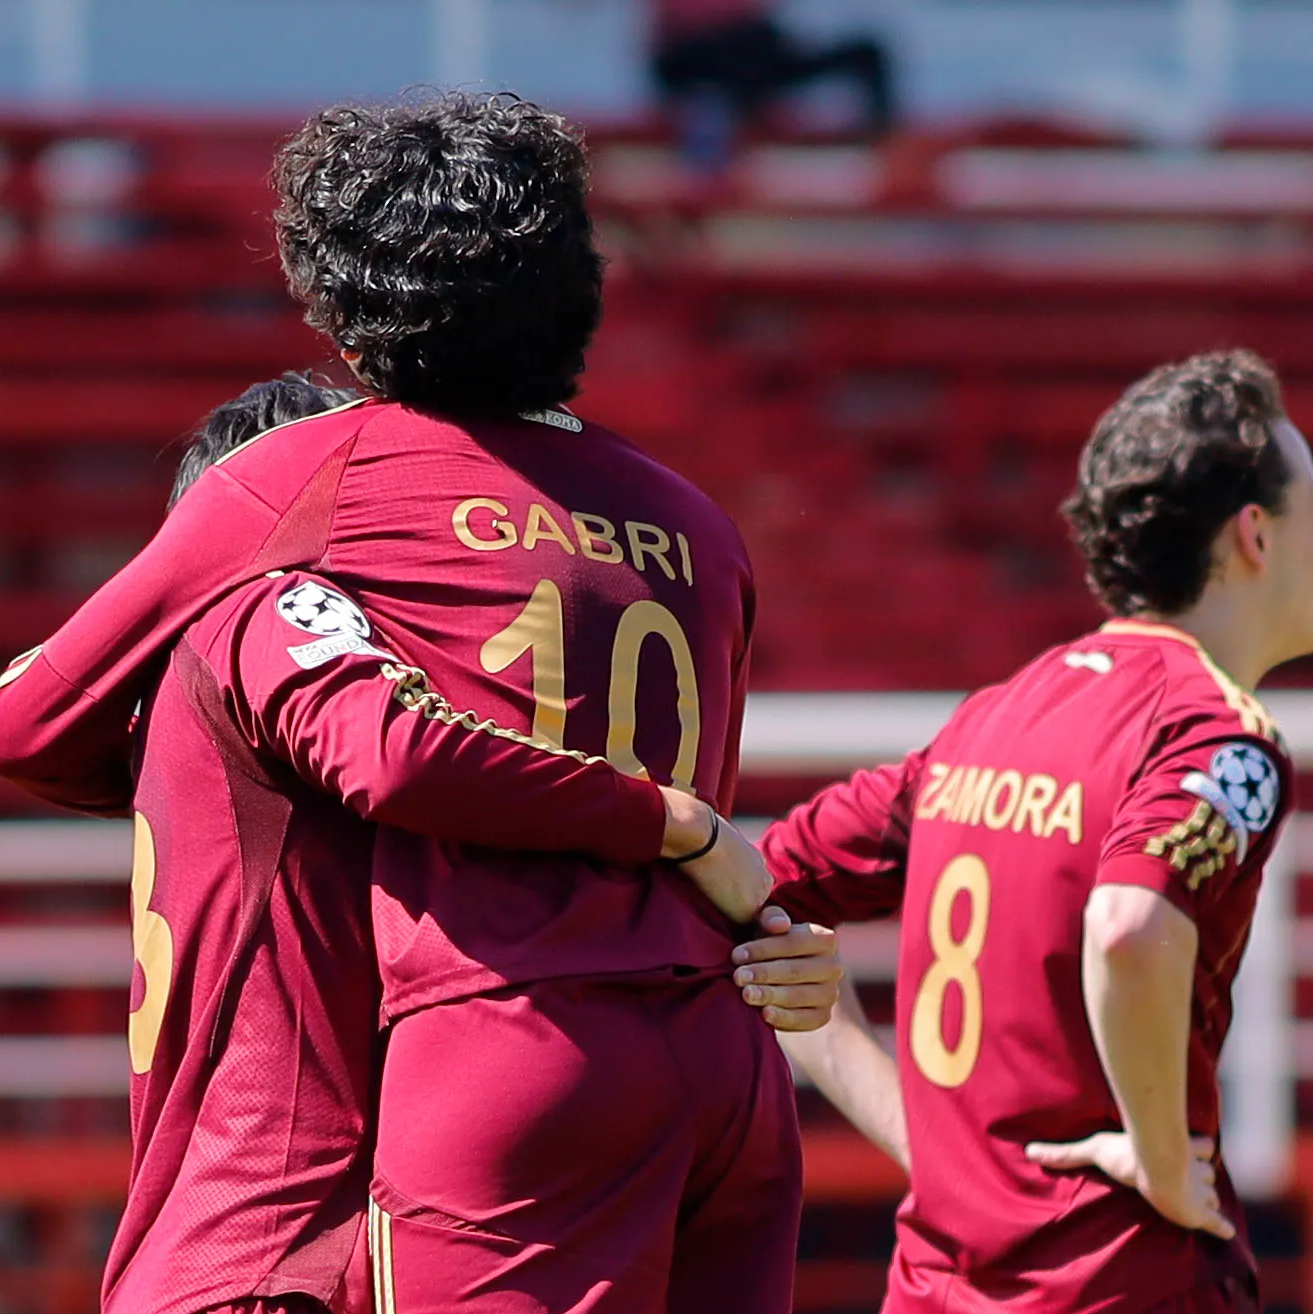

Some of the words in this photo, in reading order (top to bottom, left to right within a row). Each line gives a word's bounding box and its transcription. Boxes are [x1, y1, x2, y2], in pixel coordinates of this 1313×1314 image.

[451, 497, 694, 587] GABRI
[479, 578, 700, 795] 10
[916, 762, 1084, 845] ZAMORA
[909, 852, 992, 1089] 8
